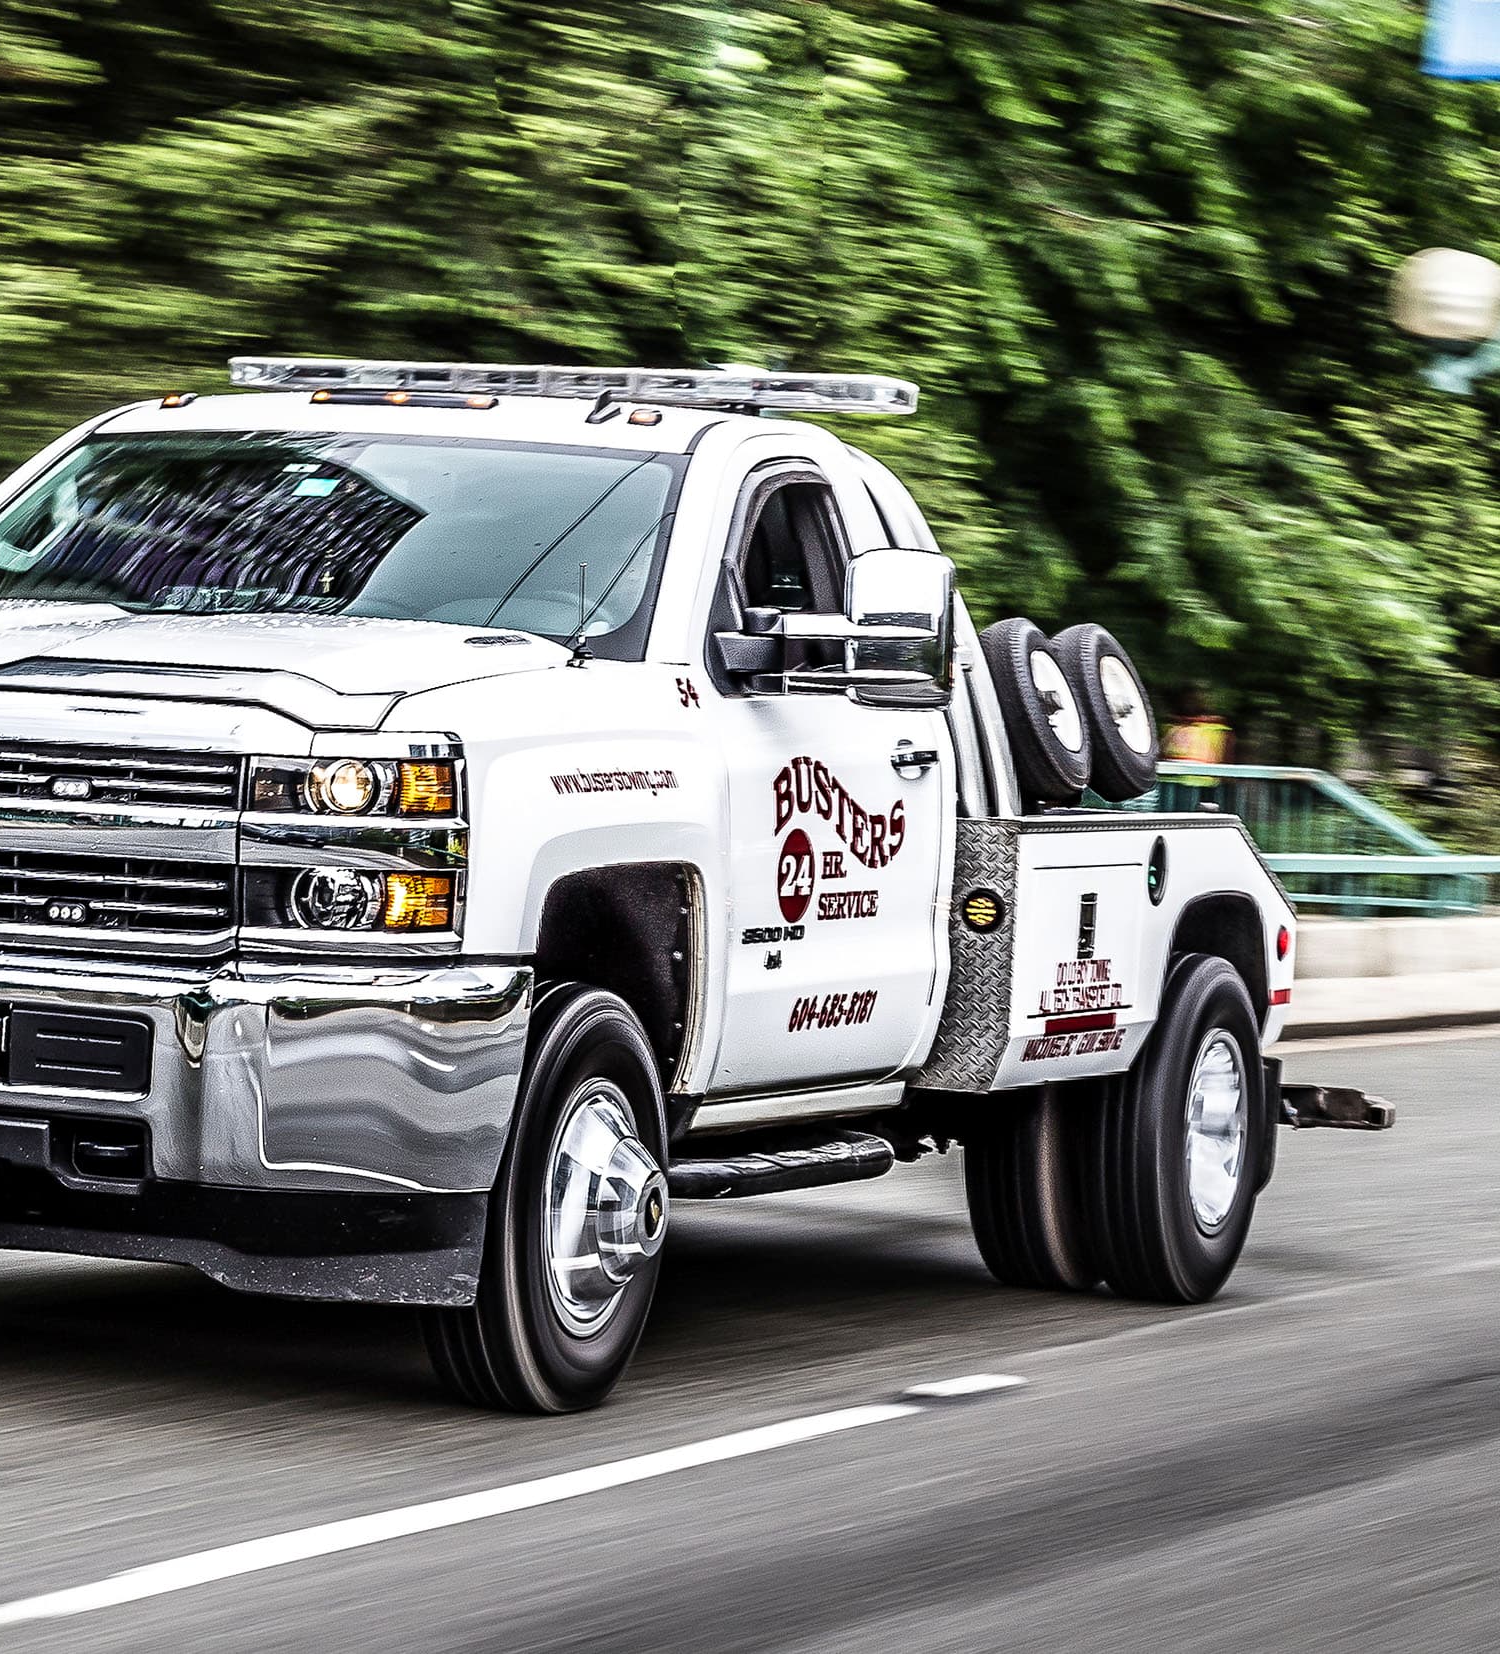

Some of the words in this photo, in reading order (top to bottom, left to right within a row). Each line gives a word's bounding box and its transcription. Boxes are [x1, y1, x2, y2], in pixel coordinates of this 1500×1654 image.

[773, 756, 906, 869] BUSTERS
[780, 855, 812, 897] 24
[817, 890, 879, 920] SERVICE
[788, 989, 878, 1033] 604-685-8181
